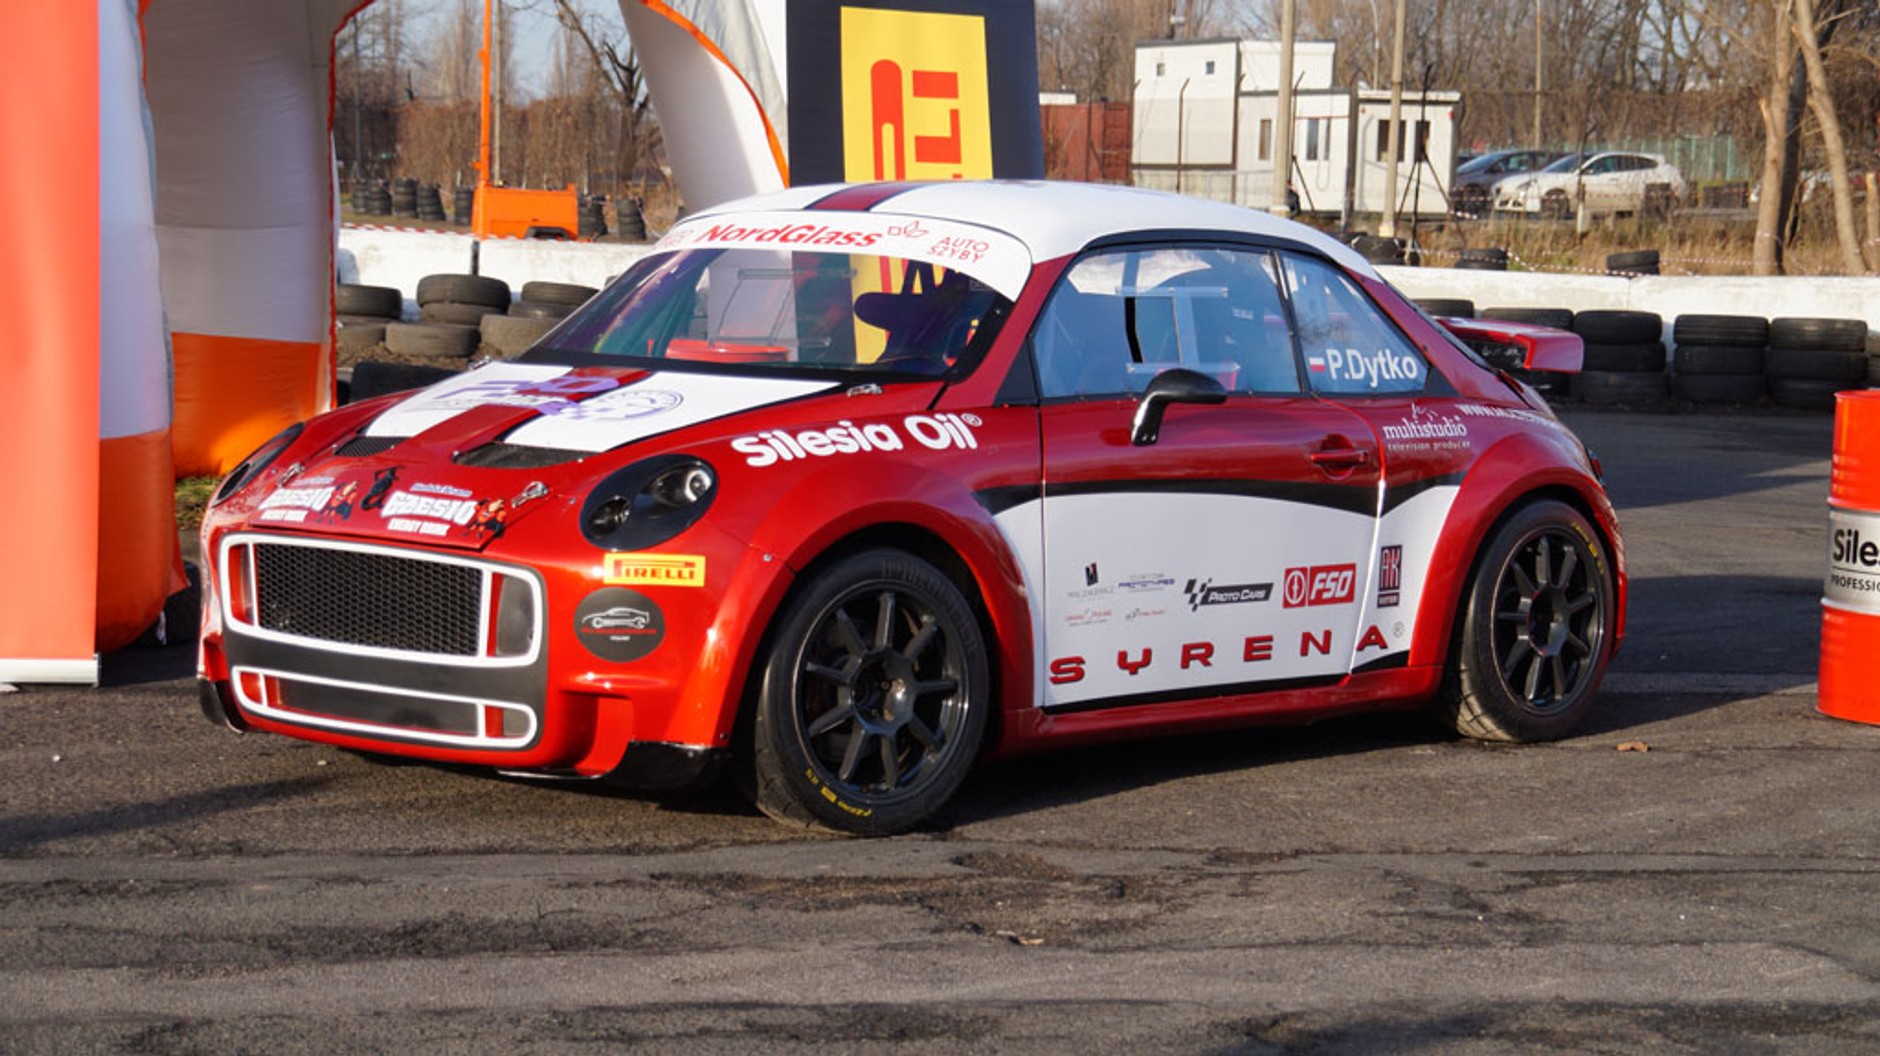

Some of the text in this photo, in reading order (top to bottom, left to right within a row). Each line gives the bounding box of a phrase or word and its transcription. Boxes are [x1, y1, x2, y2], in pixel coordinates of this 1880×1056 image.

[694, 223, 883, 247] NordGlass
[937, 236, 989, 252] AUTO
[927, 245, 984, 262] SZYBY
[1326, 348, 1418, 387] P.Dytko
[1383, 414, 1467, 439] multistudio
[731, 419, 904, 467] Silesia
[1833, 528, 1880, 567] Sile
[613, 559, 696, 580] PIRELLI
[1310, 570, 1354, 601] FSO
